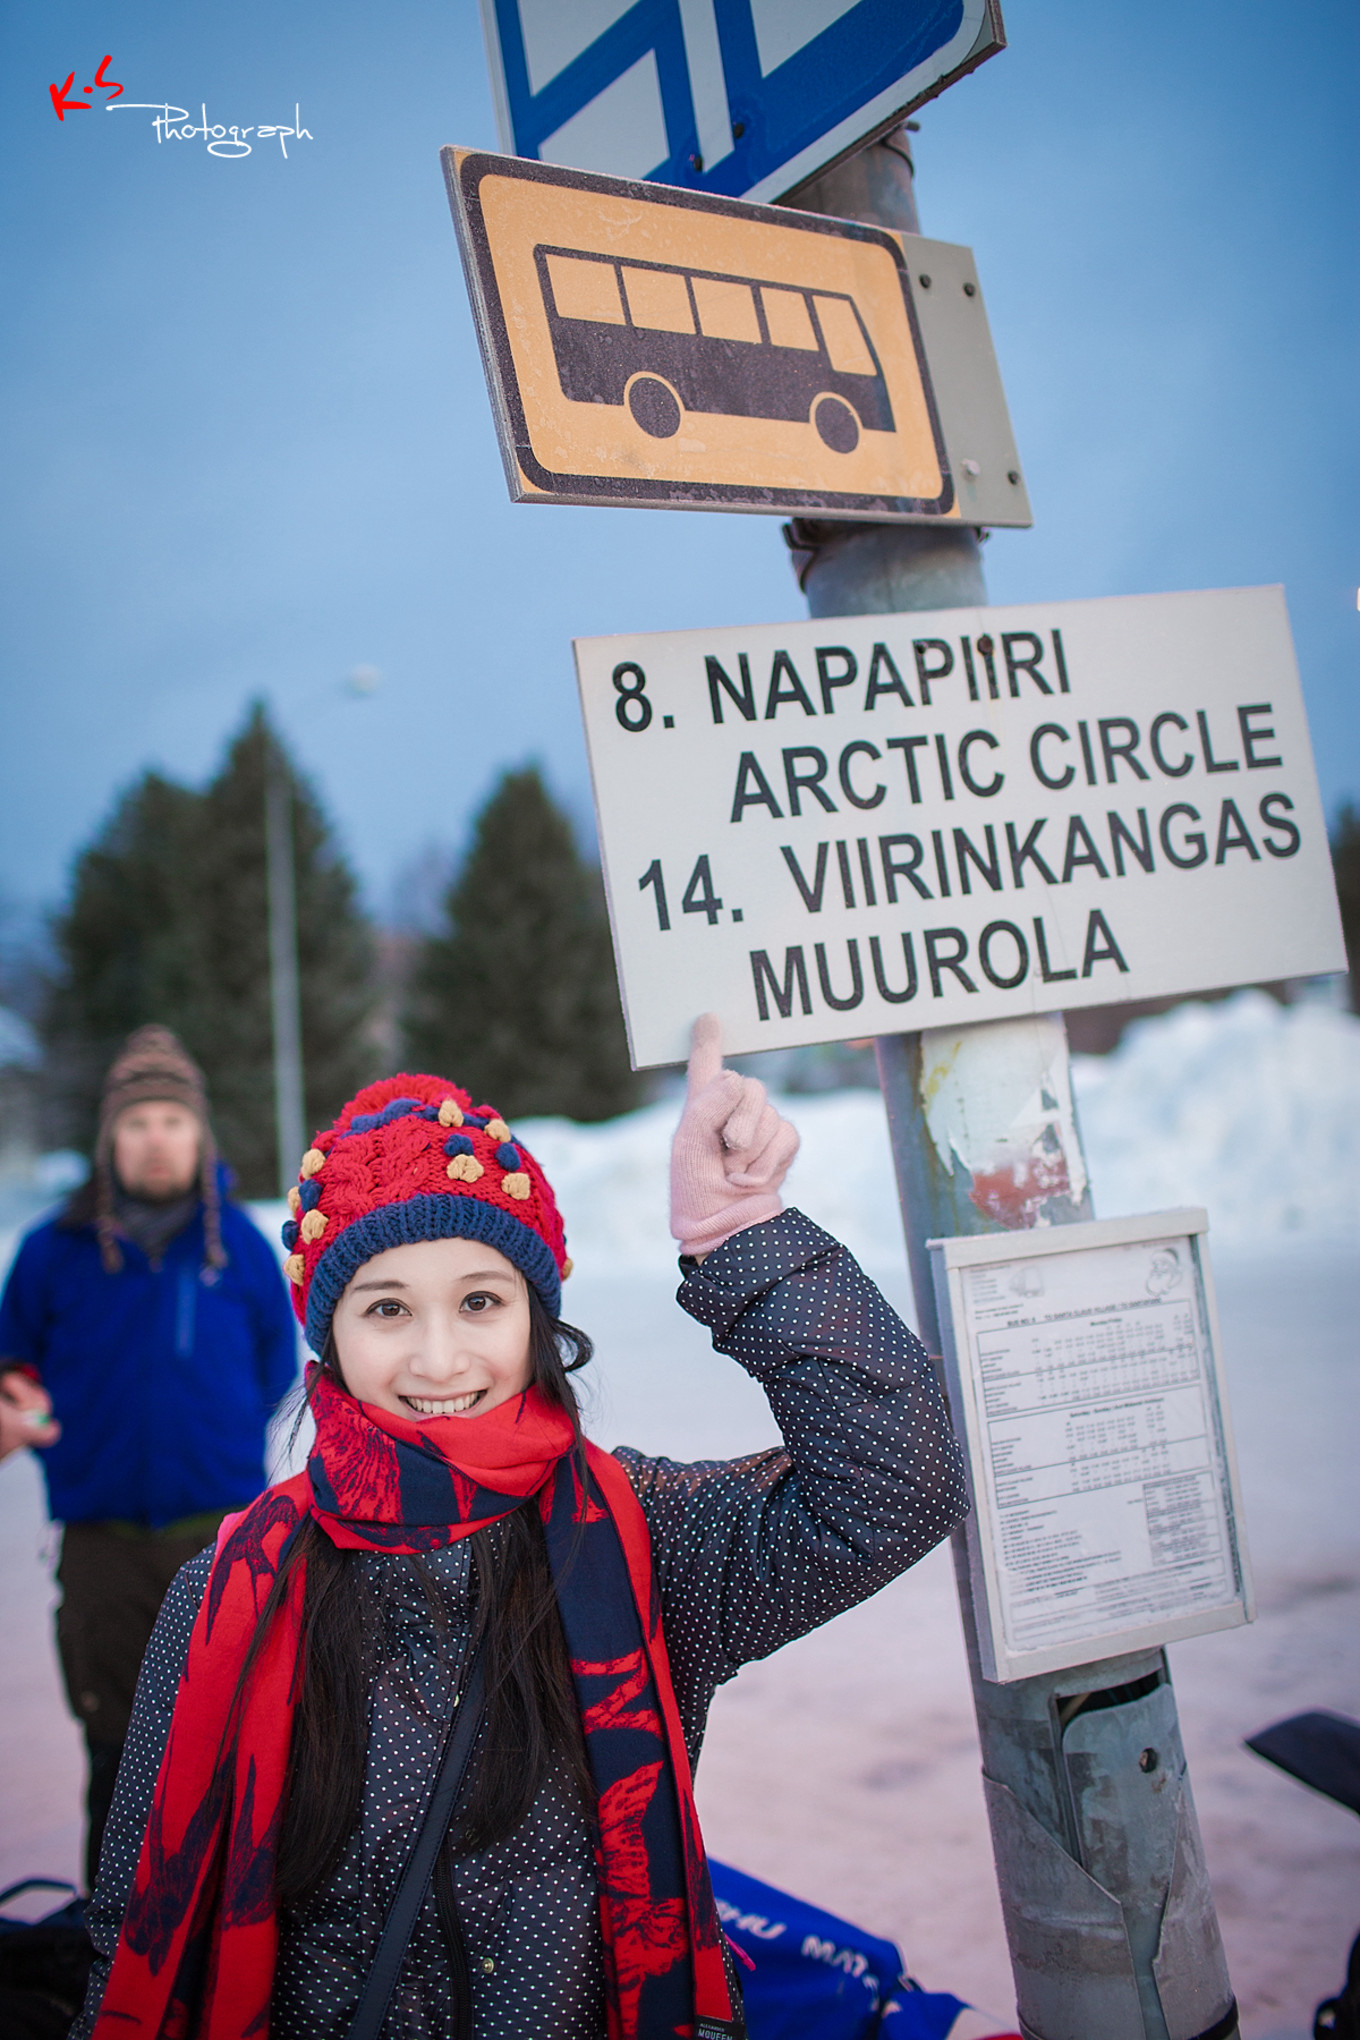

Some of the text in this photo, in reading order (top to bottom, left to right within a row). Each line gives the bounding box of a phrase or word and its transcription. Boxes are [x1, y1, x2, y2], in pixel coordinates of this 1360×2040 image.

[612, 629, 1071, 733] 8. NAPAPIIRI
[730, 703, 1284, 823] ARCTIC CIRCLE
[637, 792, 1302, 931] 14. VIIRINKANGAS
[749, 909, 1130, 1021] MUUROLA
